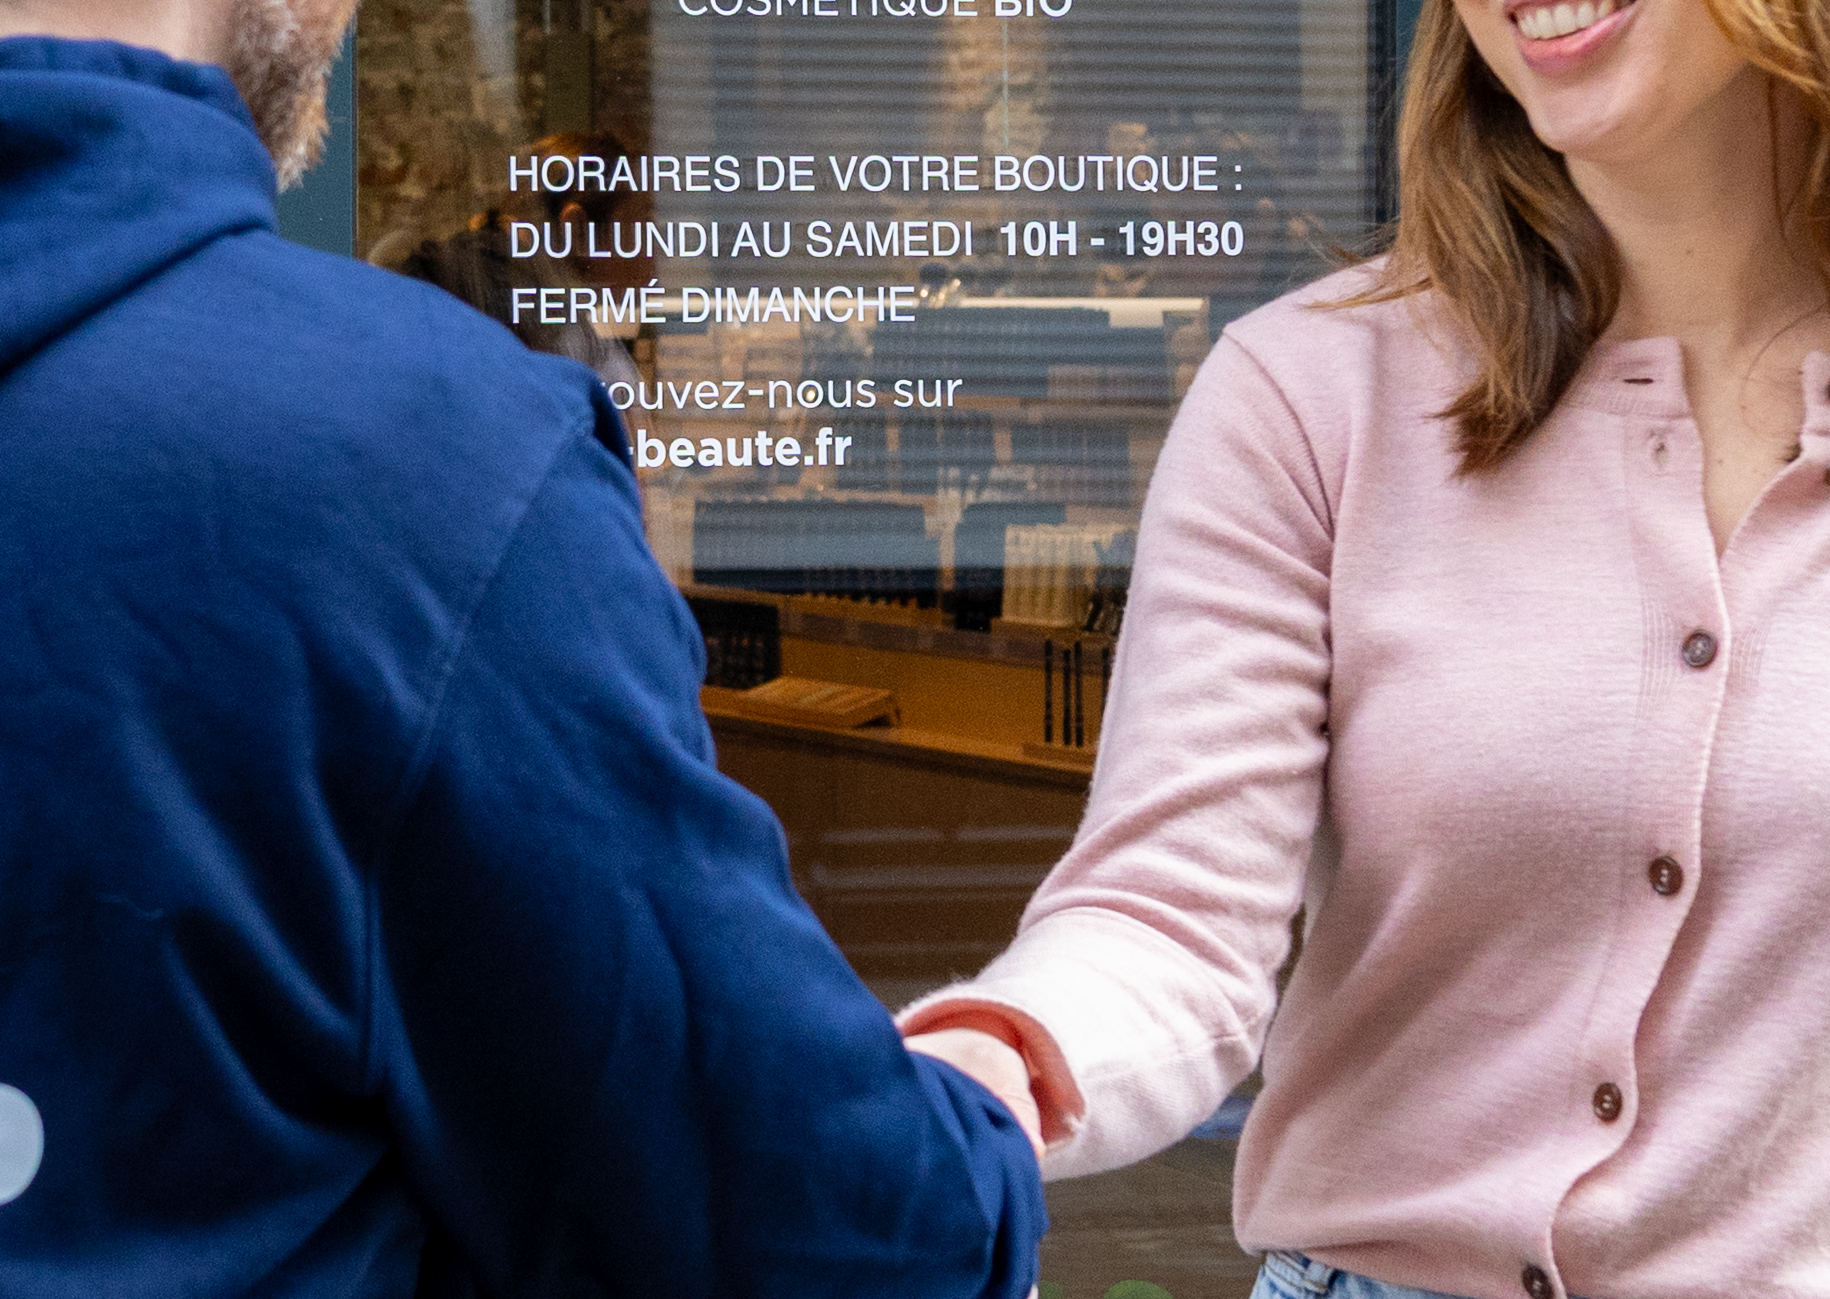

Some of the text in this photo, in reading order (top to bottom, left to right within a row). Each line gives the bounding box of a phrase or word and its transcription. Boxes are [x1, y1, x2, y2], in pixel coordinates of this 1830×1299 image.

[509, 155, 740, 193] HORAIRES
[756, 156, 815, 192] DE
[828, 156, 980, 192] VOTRE
[995, 155, 1217, 195] BOUTIQUE
[511, 221, 572, 258] DU
[588, 221, 720, 258] LUNDI
[731, 221, 791, 258] AU
[805, 220, 972, 258] SAMEDI
[999, 221, 1077, 257] 10H
[1118, 220, 1245, 257] 19H30
[511, 279, 915, 324] FERMÉ DIMANCHE
[601, 379, 963, 410] ouvez-nous sur
